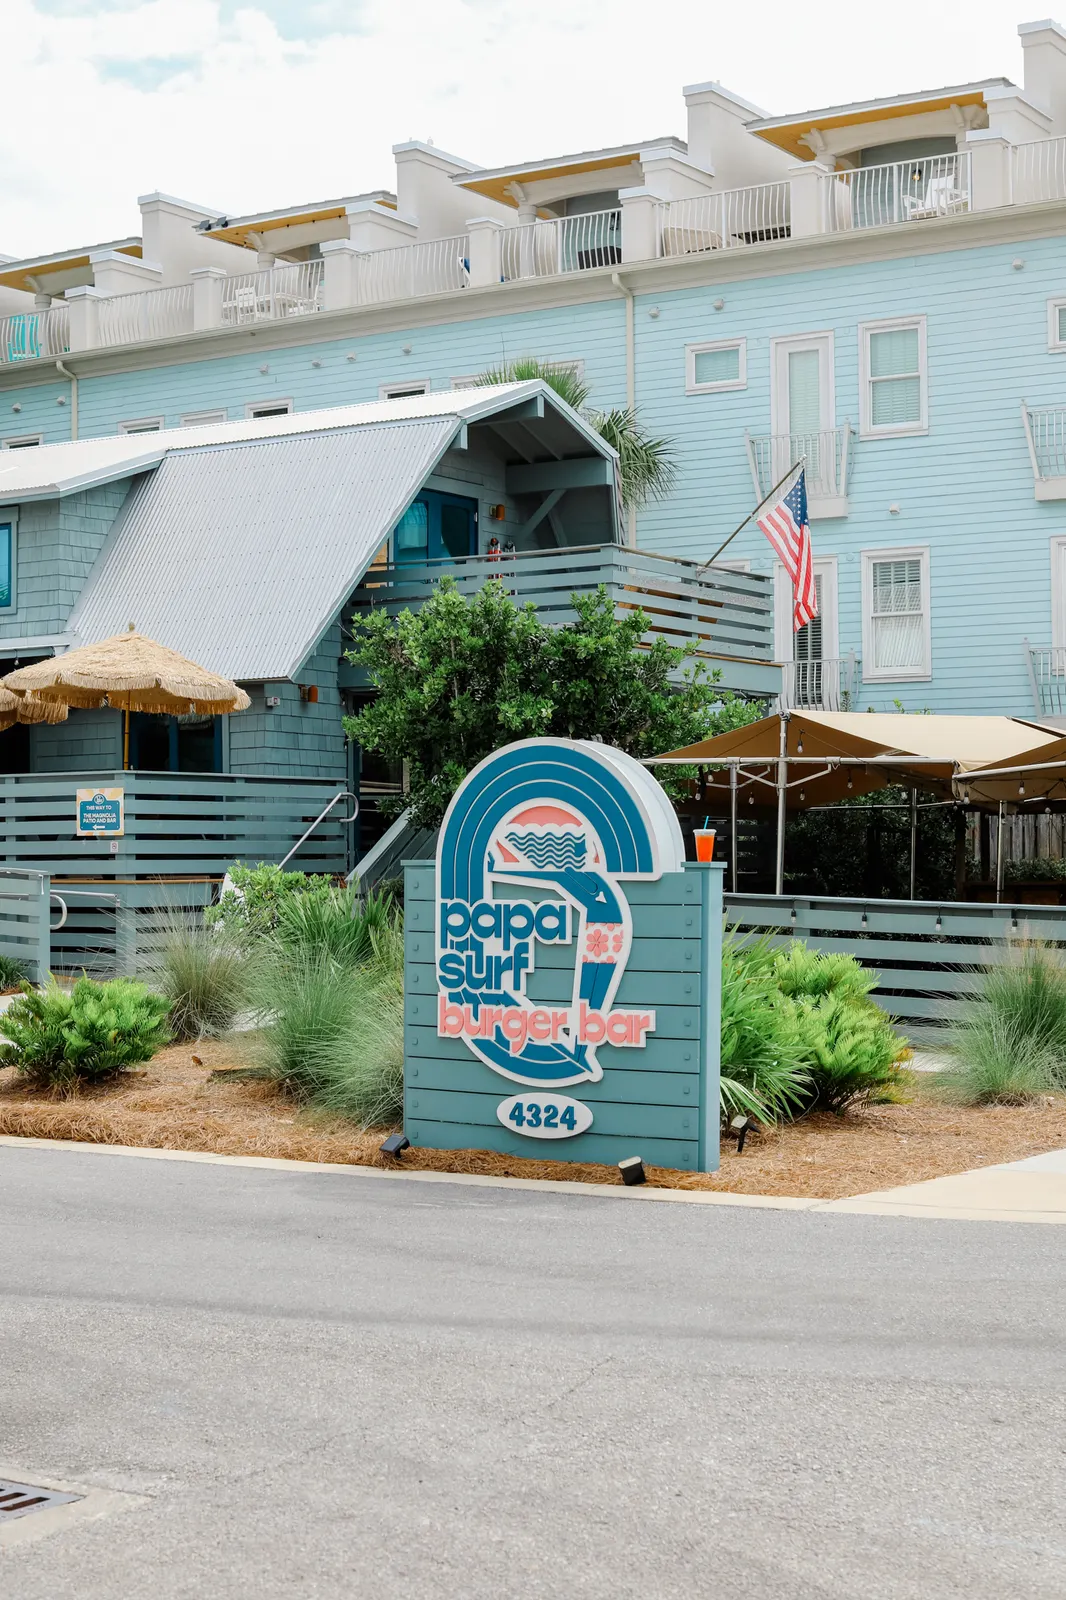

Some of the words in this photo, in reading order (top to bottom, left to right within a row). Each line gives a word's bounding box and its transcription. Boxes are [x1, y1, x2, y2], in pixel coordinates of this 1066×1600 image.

[440, 901, 567, 951] papa
[438, 941, 529, 991] surf
[438, 996, 568, 1053] burger
[579, 1003, 650, 1045] bar
[508, 1101, 578, 1131] 4324
